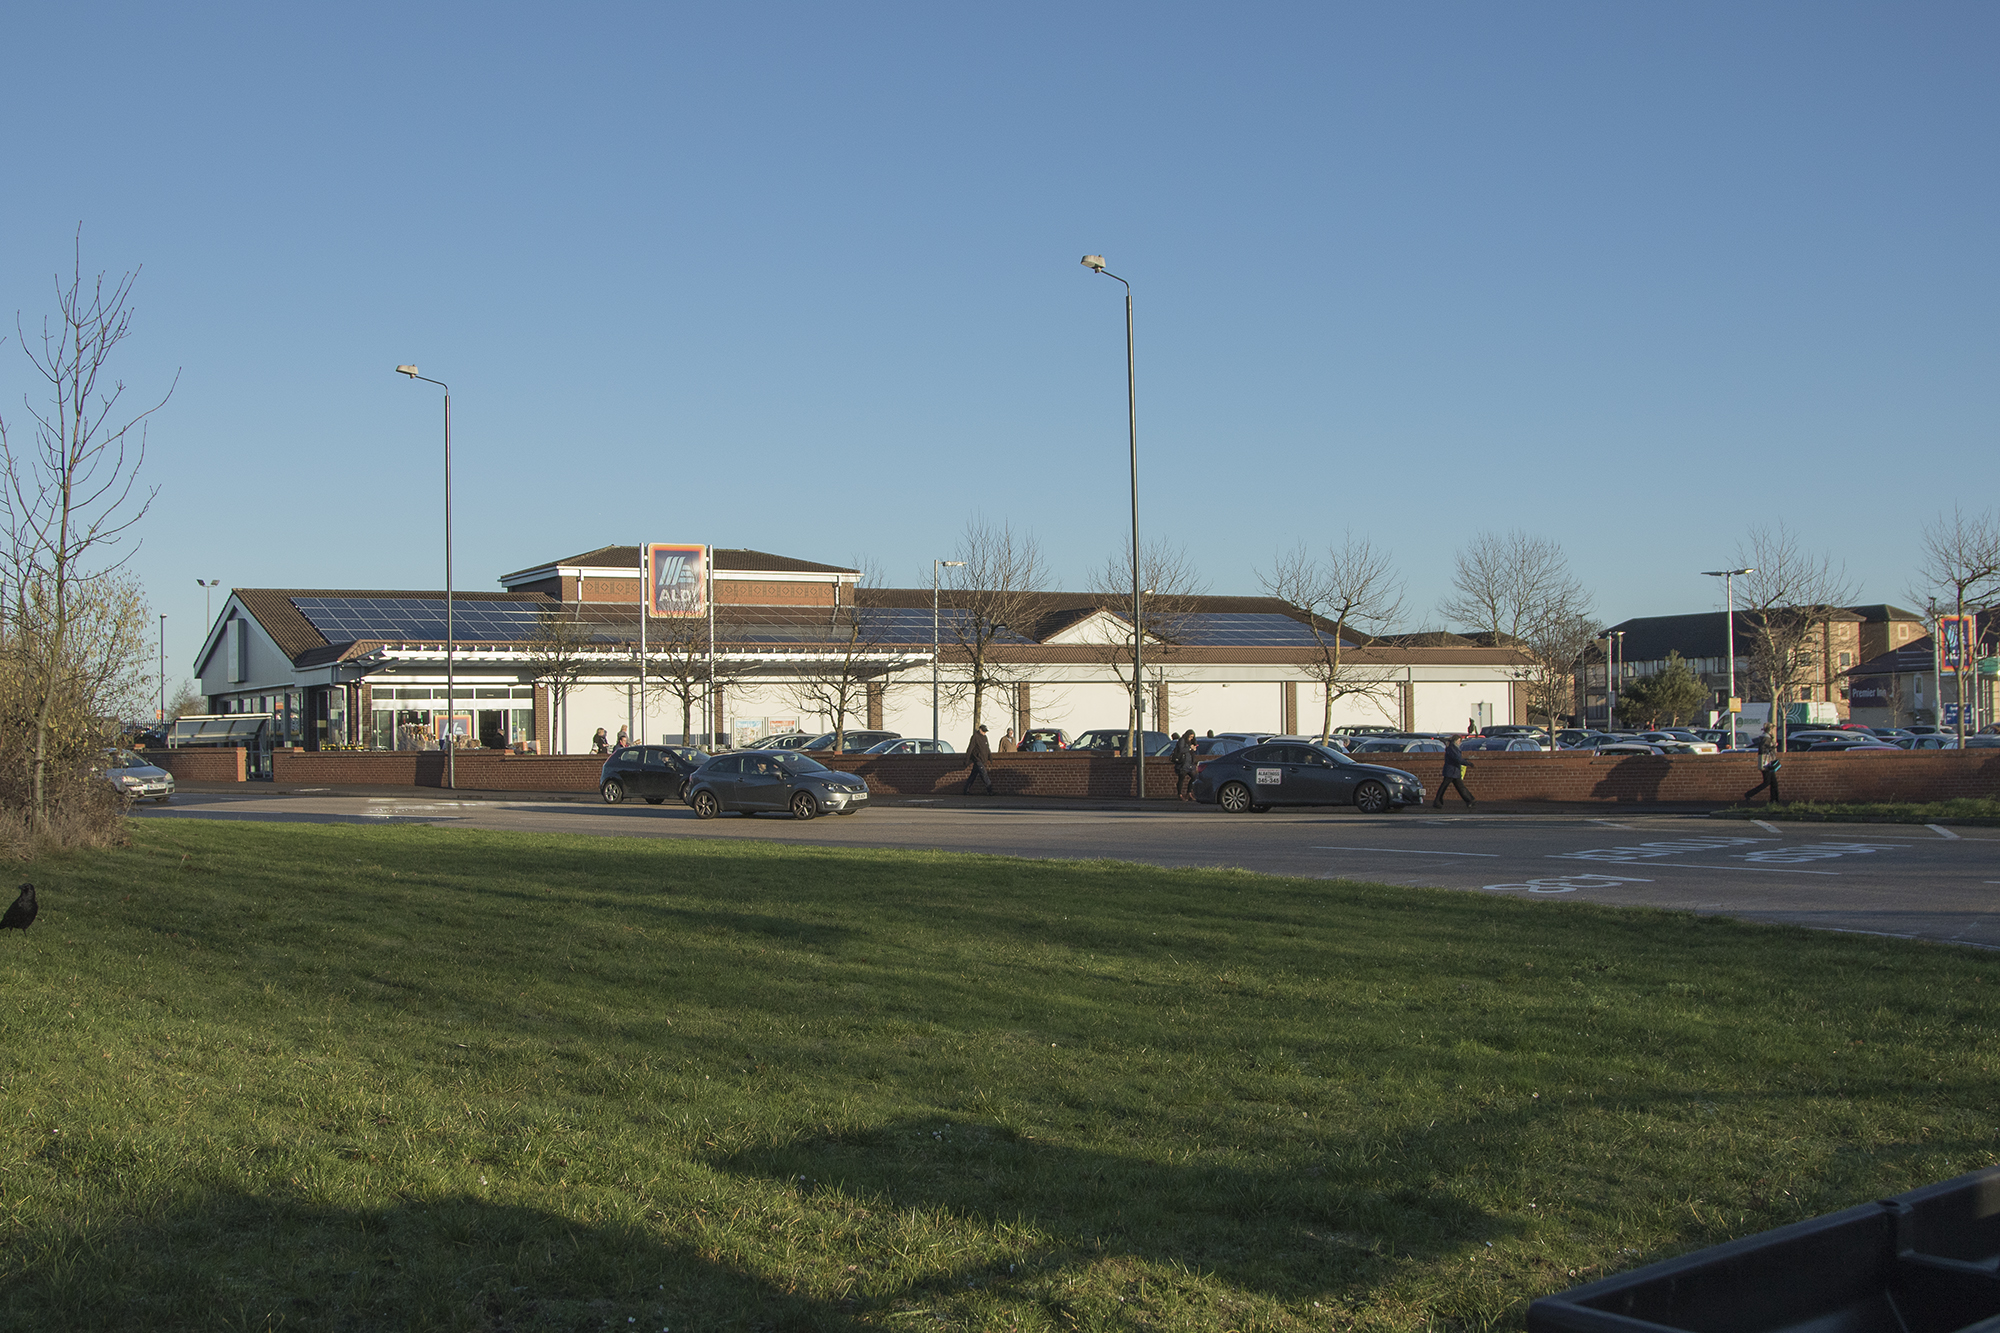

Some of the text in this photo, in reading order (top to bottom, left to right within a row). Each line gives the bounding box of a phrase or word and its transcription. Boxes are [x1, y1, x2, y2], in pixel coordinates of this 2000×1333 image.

[1852, 687, 1887, 698] Premier Inn
[1481, 873, 1656, 894] A38
